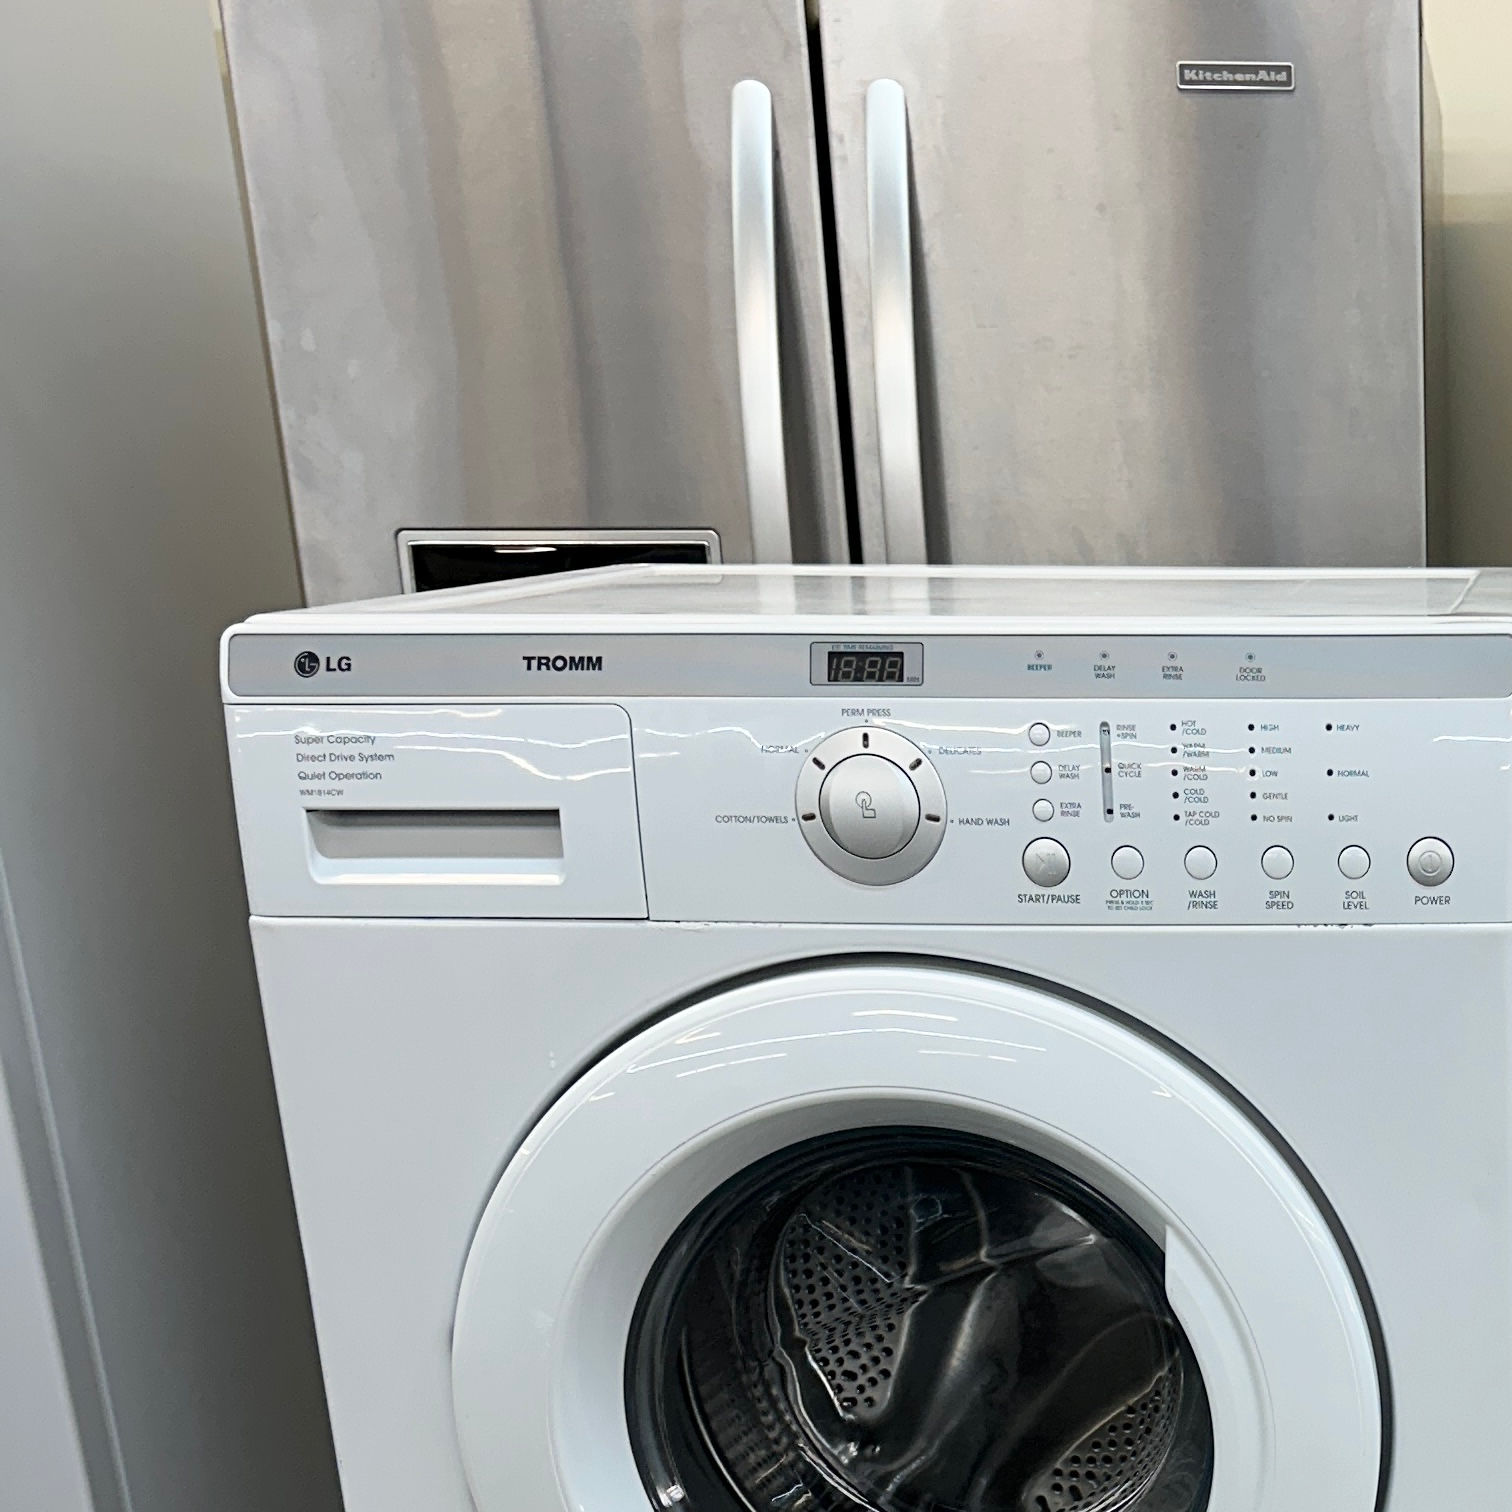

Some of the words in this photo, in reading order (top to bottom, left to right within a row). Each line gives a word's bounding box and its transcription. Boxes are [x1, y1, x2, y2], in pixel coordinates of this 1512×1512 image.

[1184, 69, 1288, 82] KitchenAid
[325, 656, 352, 672] LG
[523, 656, 603, 672] TROMM
[1027, 664, 1053, 672] BEEPER
[1093, 664, 1116, 672] DELAY
[1161, 665, 1184, 673] EXTRA
[1094, 672, 1116, 680] WASH
[1162, 673, 1183, 681] RINSE
[1236, 674, 1266, 682] LOCKED
[841, 708, 865, 717] PERM
[867, 708, 891, 717] PRESS
[1181, 719, 1197, 727] HOT
[1260, 723, 1280, 731] HIGH
[1336, 723, 1360, 732] HEAVY
[1116, 724, 1137, 732] RINSE
[1057, 730, 1082, 738] BEEPER
[294, 734, 324, 746] Super
[326, 734, 377, 746] Capacity
[1261, 746, 1291, 755] MEDIUM
[296, 752, 327, 763] Direct
[328, 752, 356, 763] Drive
[358, 752, 396, 764] System
[1058, 764, 1080, 772] DELAY
[1118, 762, 1142, 770] QUICK
[297, 770, 326, 781] Quiet
[328, 770, 383, 782] Operation
[1059, 772, 1080, 780] WASH
[1118, 770, 1142, 778] CYCLE
[1262, 769, 1278, 778] LOW
[1337, 769, 1370, 778] NORMAL
[1183, 788, 1205, 796] COLD
[1262, 791, 1288, 800] GENTLE
[1060, 802, 1082, 810] EXTRA
[1060, 810, 1081, 818] RINSE
[1119, 811, 1141, 819] WASH
[1184, 811, 1198, 819] TAP
[1199, 811, 1220, 819] COLD
[1263, 814, 1276, 823] NO
[1277, 815, 1293, 823] SPIN
[1338, 814, 1359, 823] LIGHT
[715, 815, 789, 824] COTTON/TOWELS
[958, 817, 983, 826] HAND
[984, 817, 1010, 826] WASH
[1110, 888, 1149, 899] OPTION
[1188, 889, 1216, 899] WASH
[1268, 890, 1291, 900] SPIN
[1344, 890, 1367, 900] SOIL
[1017, 893, 1081, 905] START/PAUSE
[1414, 895, 1451, 906] POWER
[1187, 900, 1219, 910] /RINSE
[1265, 900, 1294, 911] SPEED
[1342, 900, 1370, 911] LEVEL
